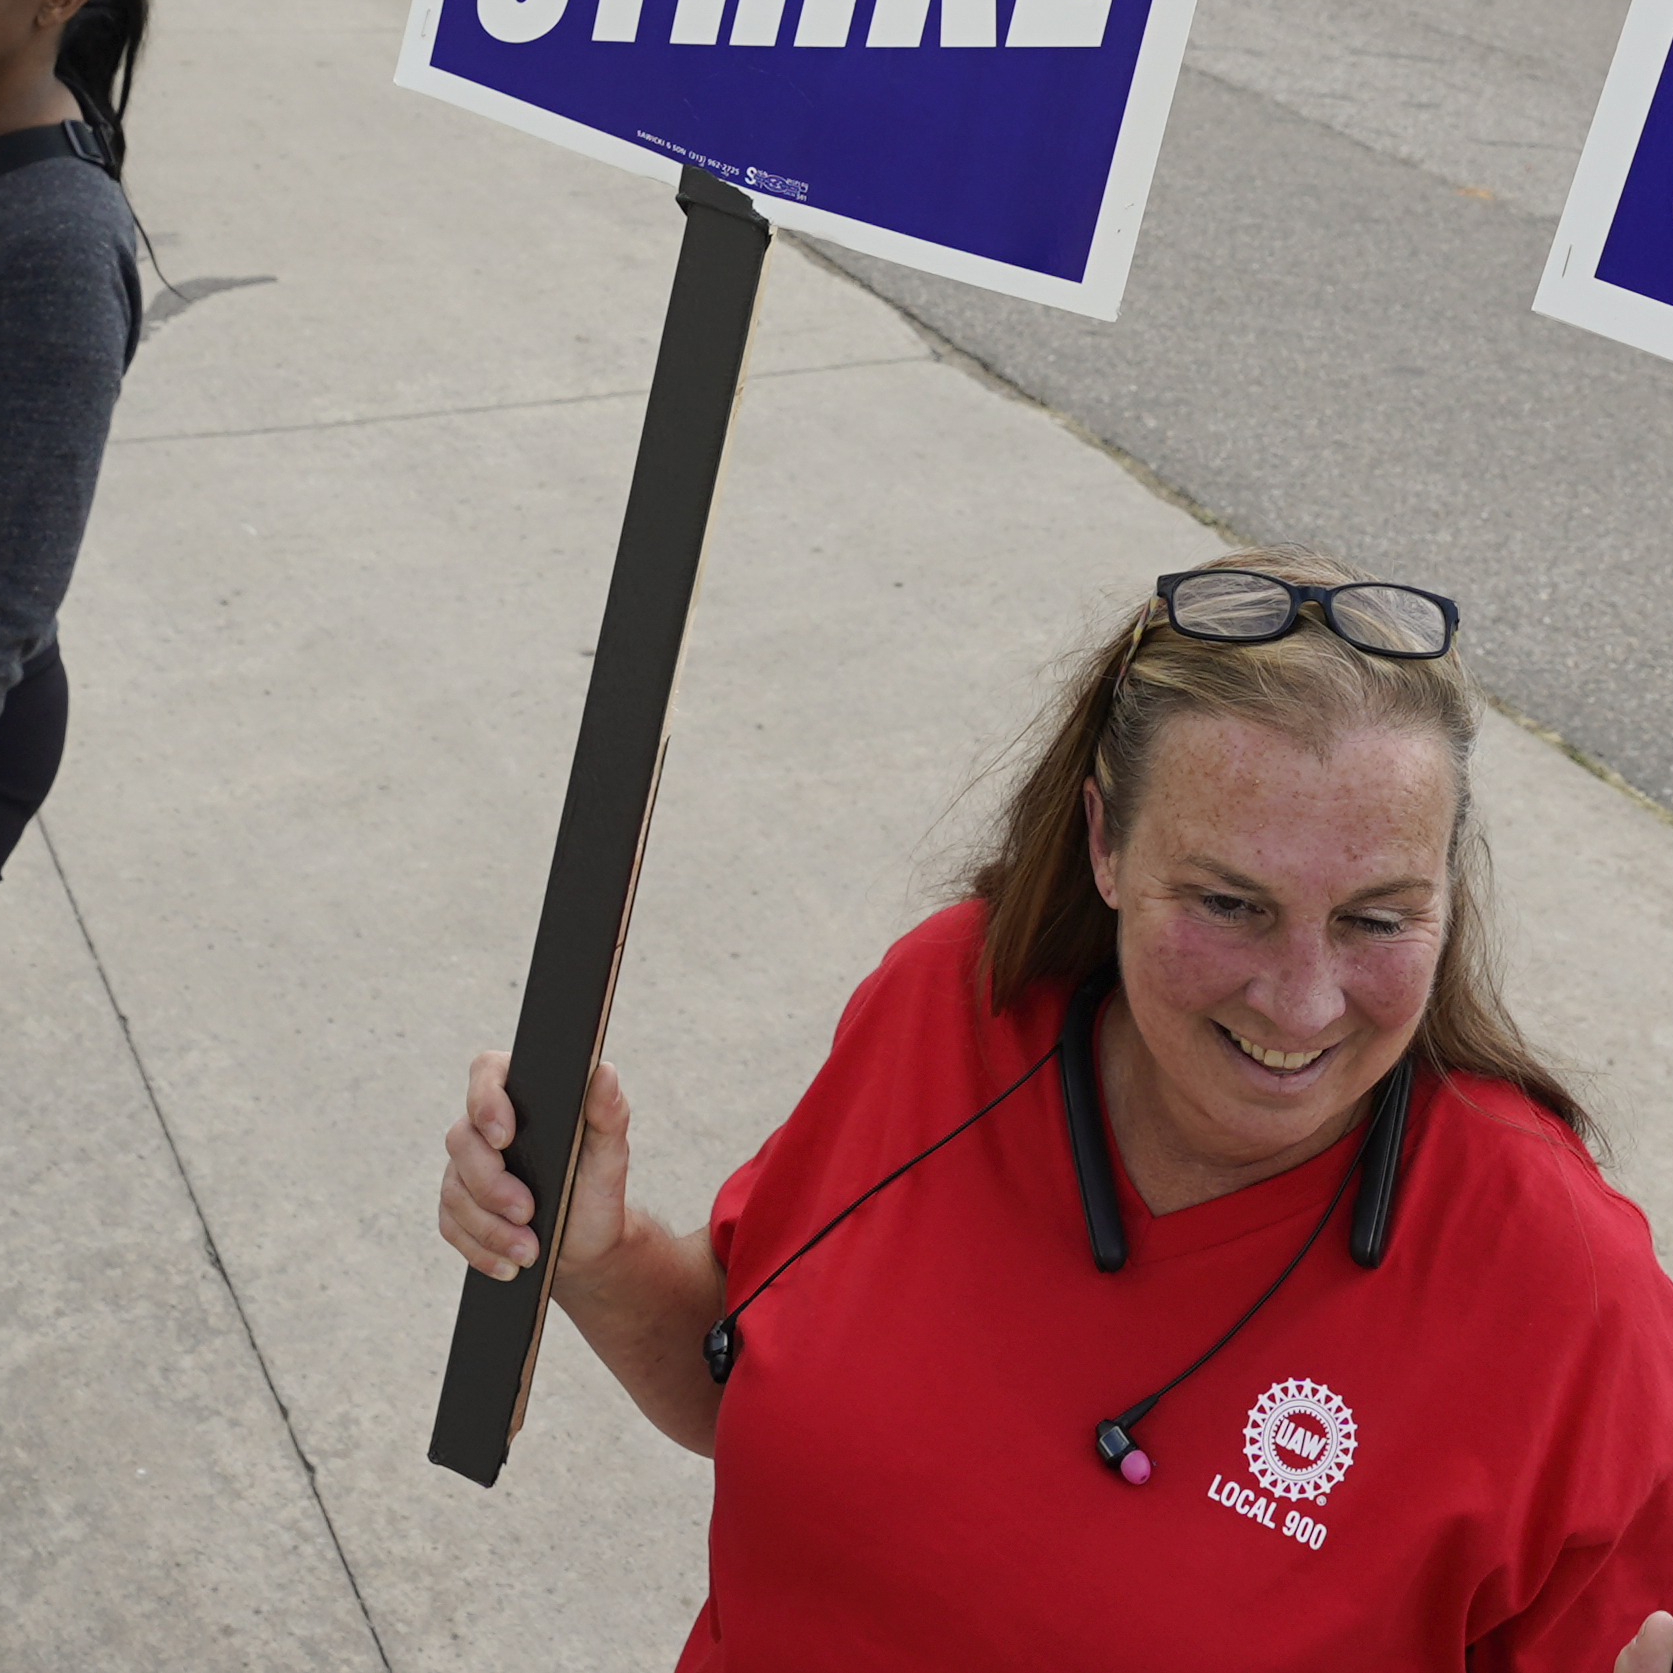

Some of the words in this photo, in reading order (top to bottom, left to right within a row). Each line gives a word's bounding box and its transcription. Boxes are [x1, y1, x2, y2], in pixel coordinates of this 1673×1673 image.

[1276, 1417, 1327, 1461] UAW
[1207, 1474, 1277, 1529] LOCAL
[1282, 1510, 1328, 1551] 900
